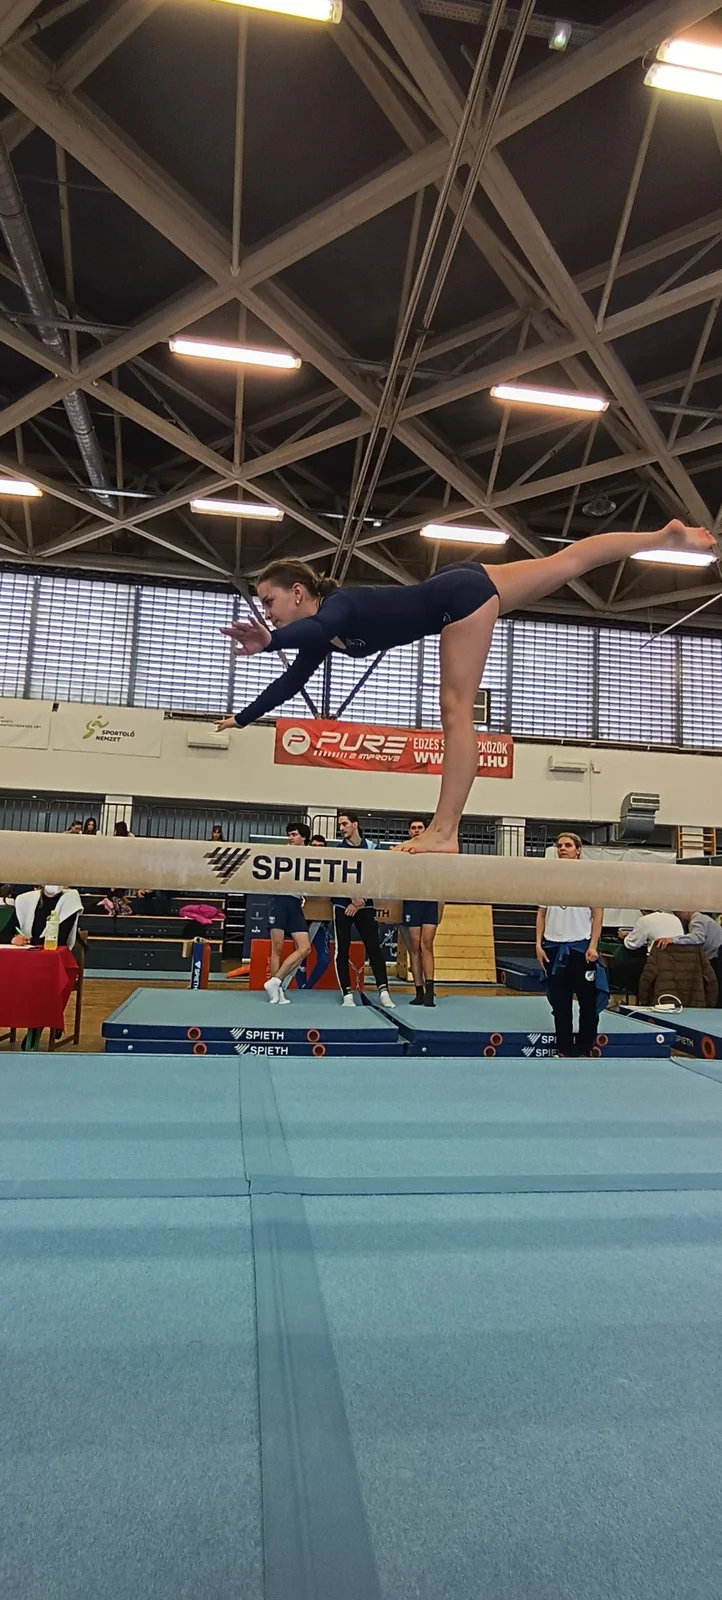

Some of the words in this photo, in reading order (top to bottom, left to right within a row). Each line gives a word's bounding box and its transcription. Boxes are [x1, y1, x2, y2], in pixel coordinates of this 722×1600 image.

[316, 731, 409, 755] PURE
[413, 737, 439, 751] EDZÉS
[358, 754, 401, 762] IMPROVE
[252, 855, 362, 884] SPIETH
[245, 1030, 284, 1040] SPIETH
[250, 1046, 289, 1056] SPIETH
